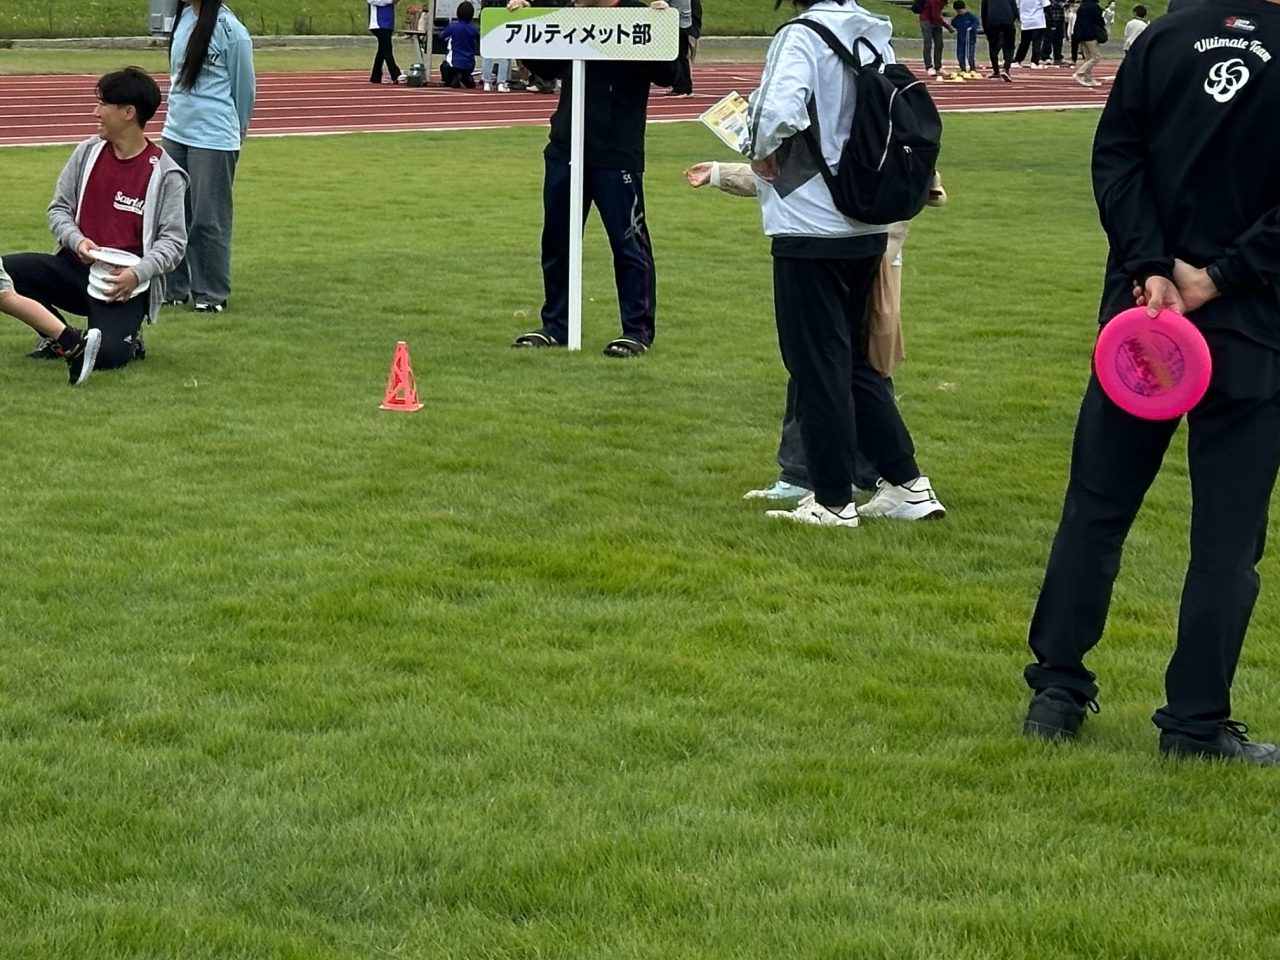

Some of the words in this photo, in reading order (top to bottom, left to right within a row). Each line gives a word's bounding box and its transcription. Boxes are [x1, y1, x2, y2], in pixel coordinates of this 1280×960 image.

[505, 23, 652, 46] アルティメット部
[1194, 36, 1249, 53] Ultimate
[1249, 40, 1272, 63] Team
